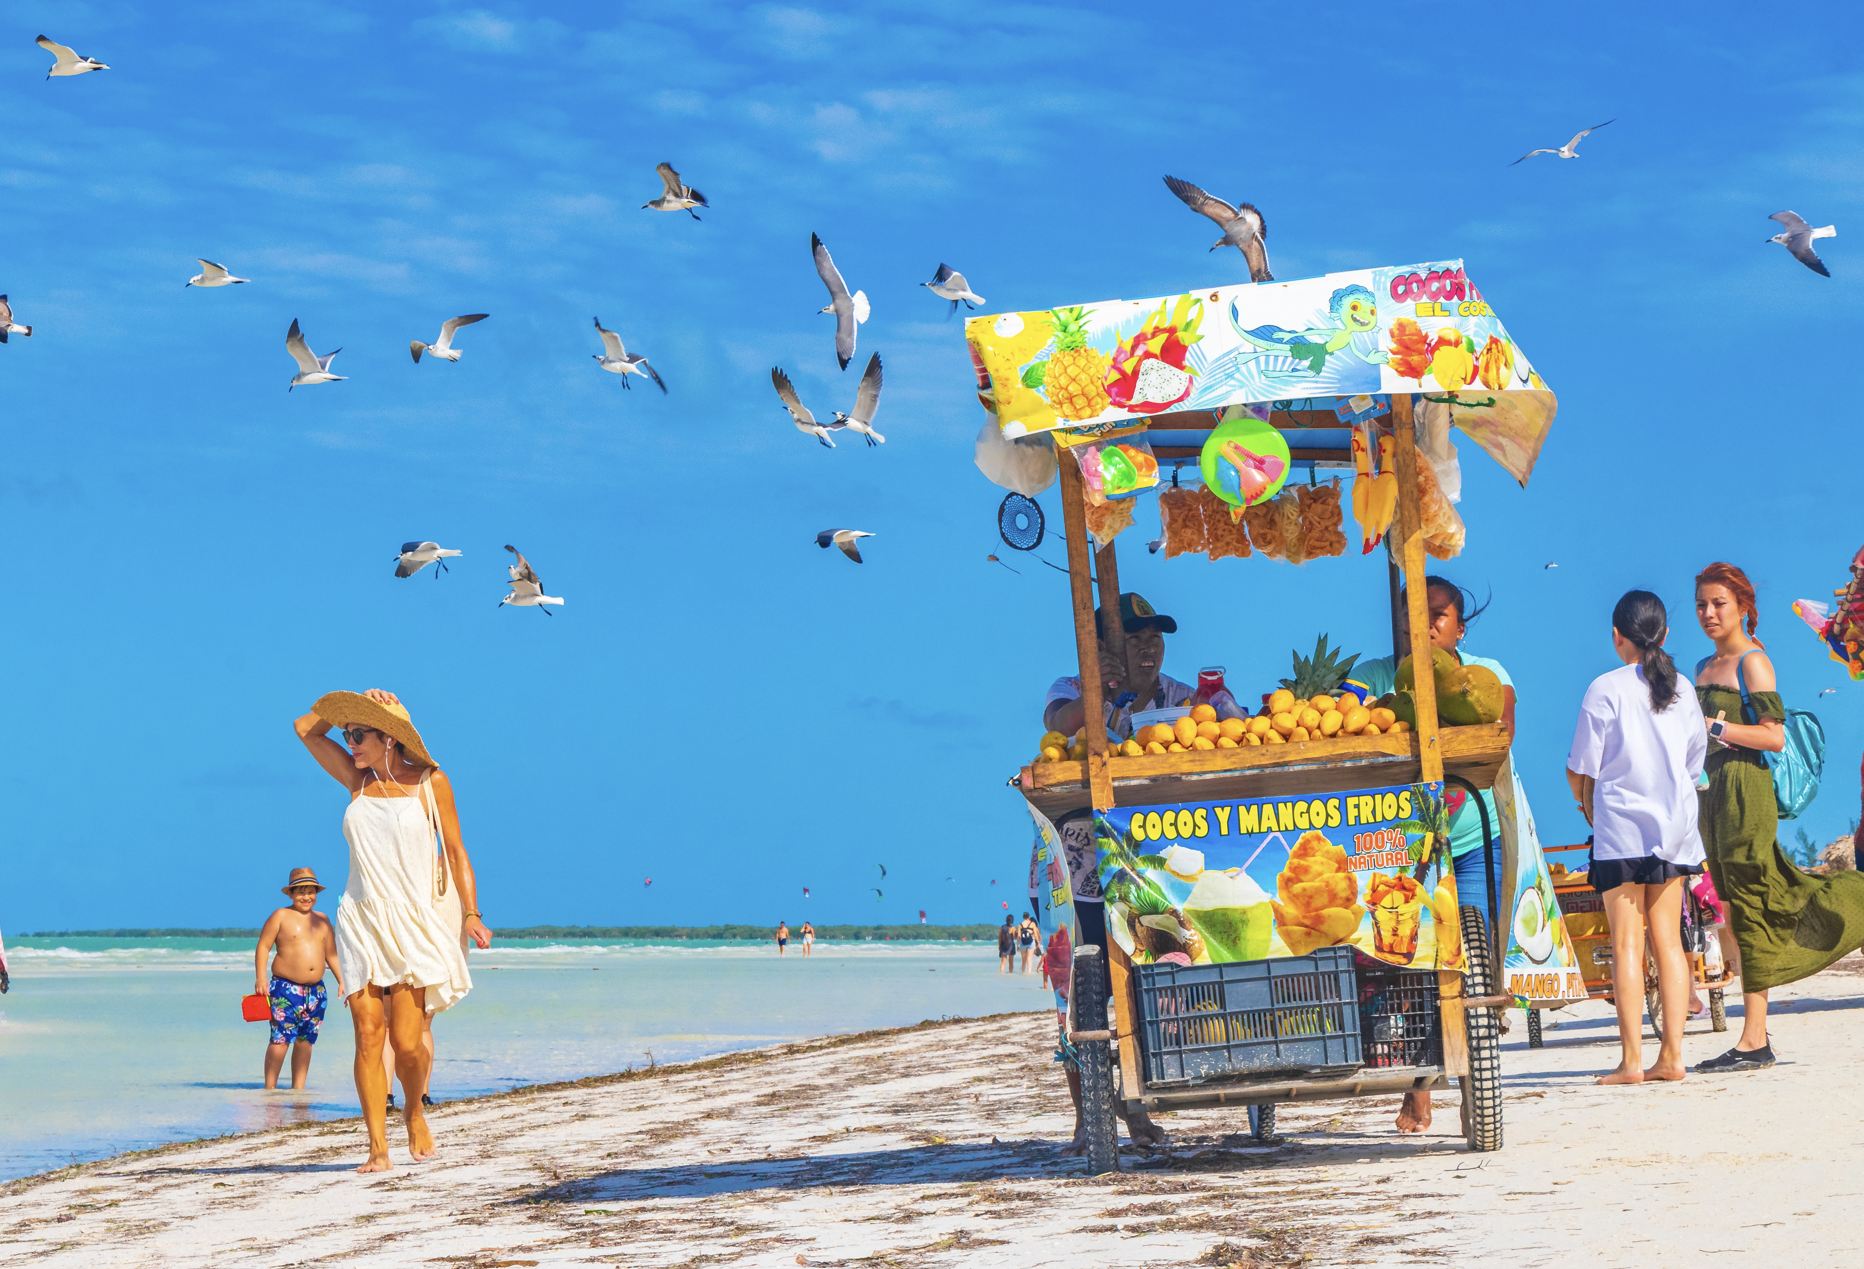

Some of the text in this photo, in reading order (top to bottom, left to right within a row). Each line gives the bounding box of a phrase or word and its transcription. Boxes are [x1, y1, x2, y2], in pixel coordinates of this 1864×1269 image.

[1390, 267, 1467, 303] COCOS
[1415, 301, 1450, 317] EL
[1130, 790, 1413, 842] COCOS Y MANGOS FRIOS
[1353, 827, 1407, 854] 100%
[1347, 850, 1414, 872] NATURAL
